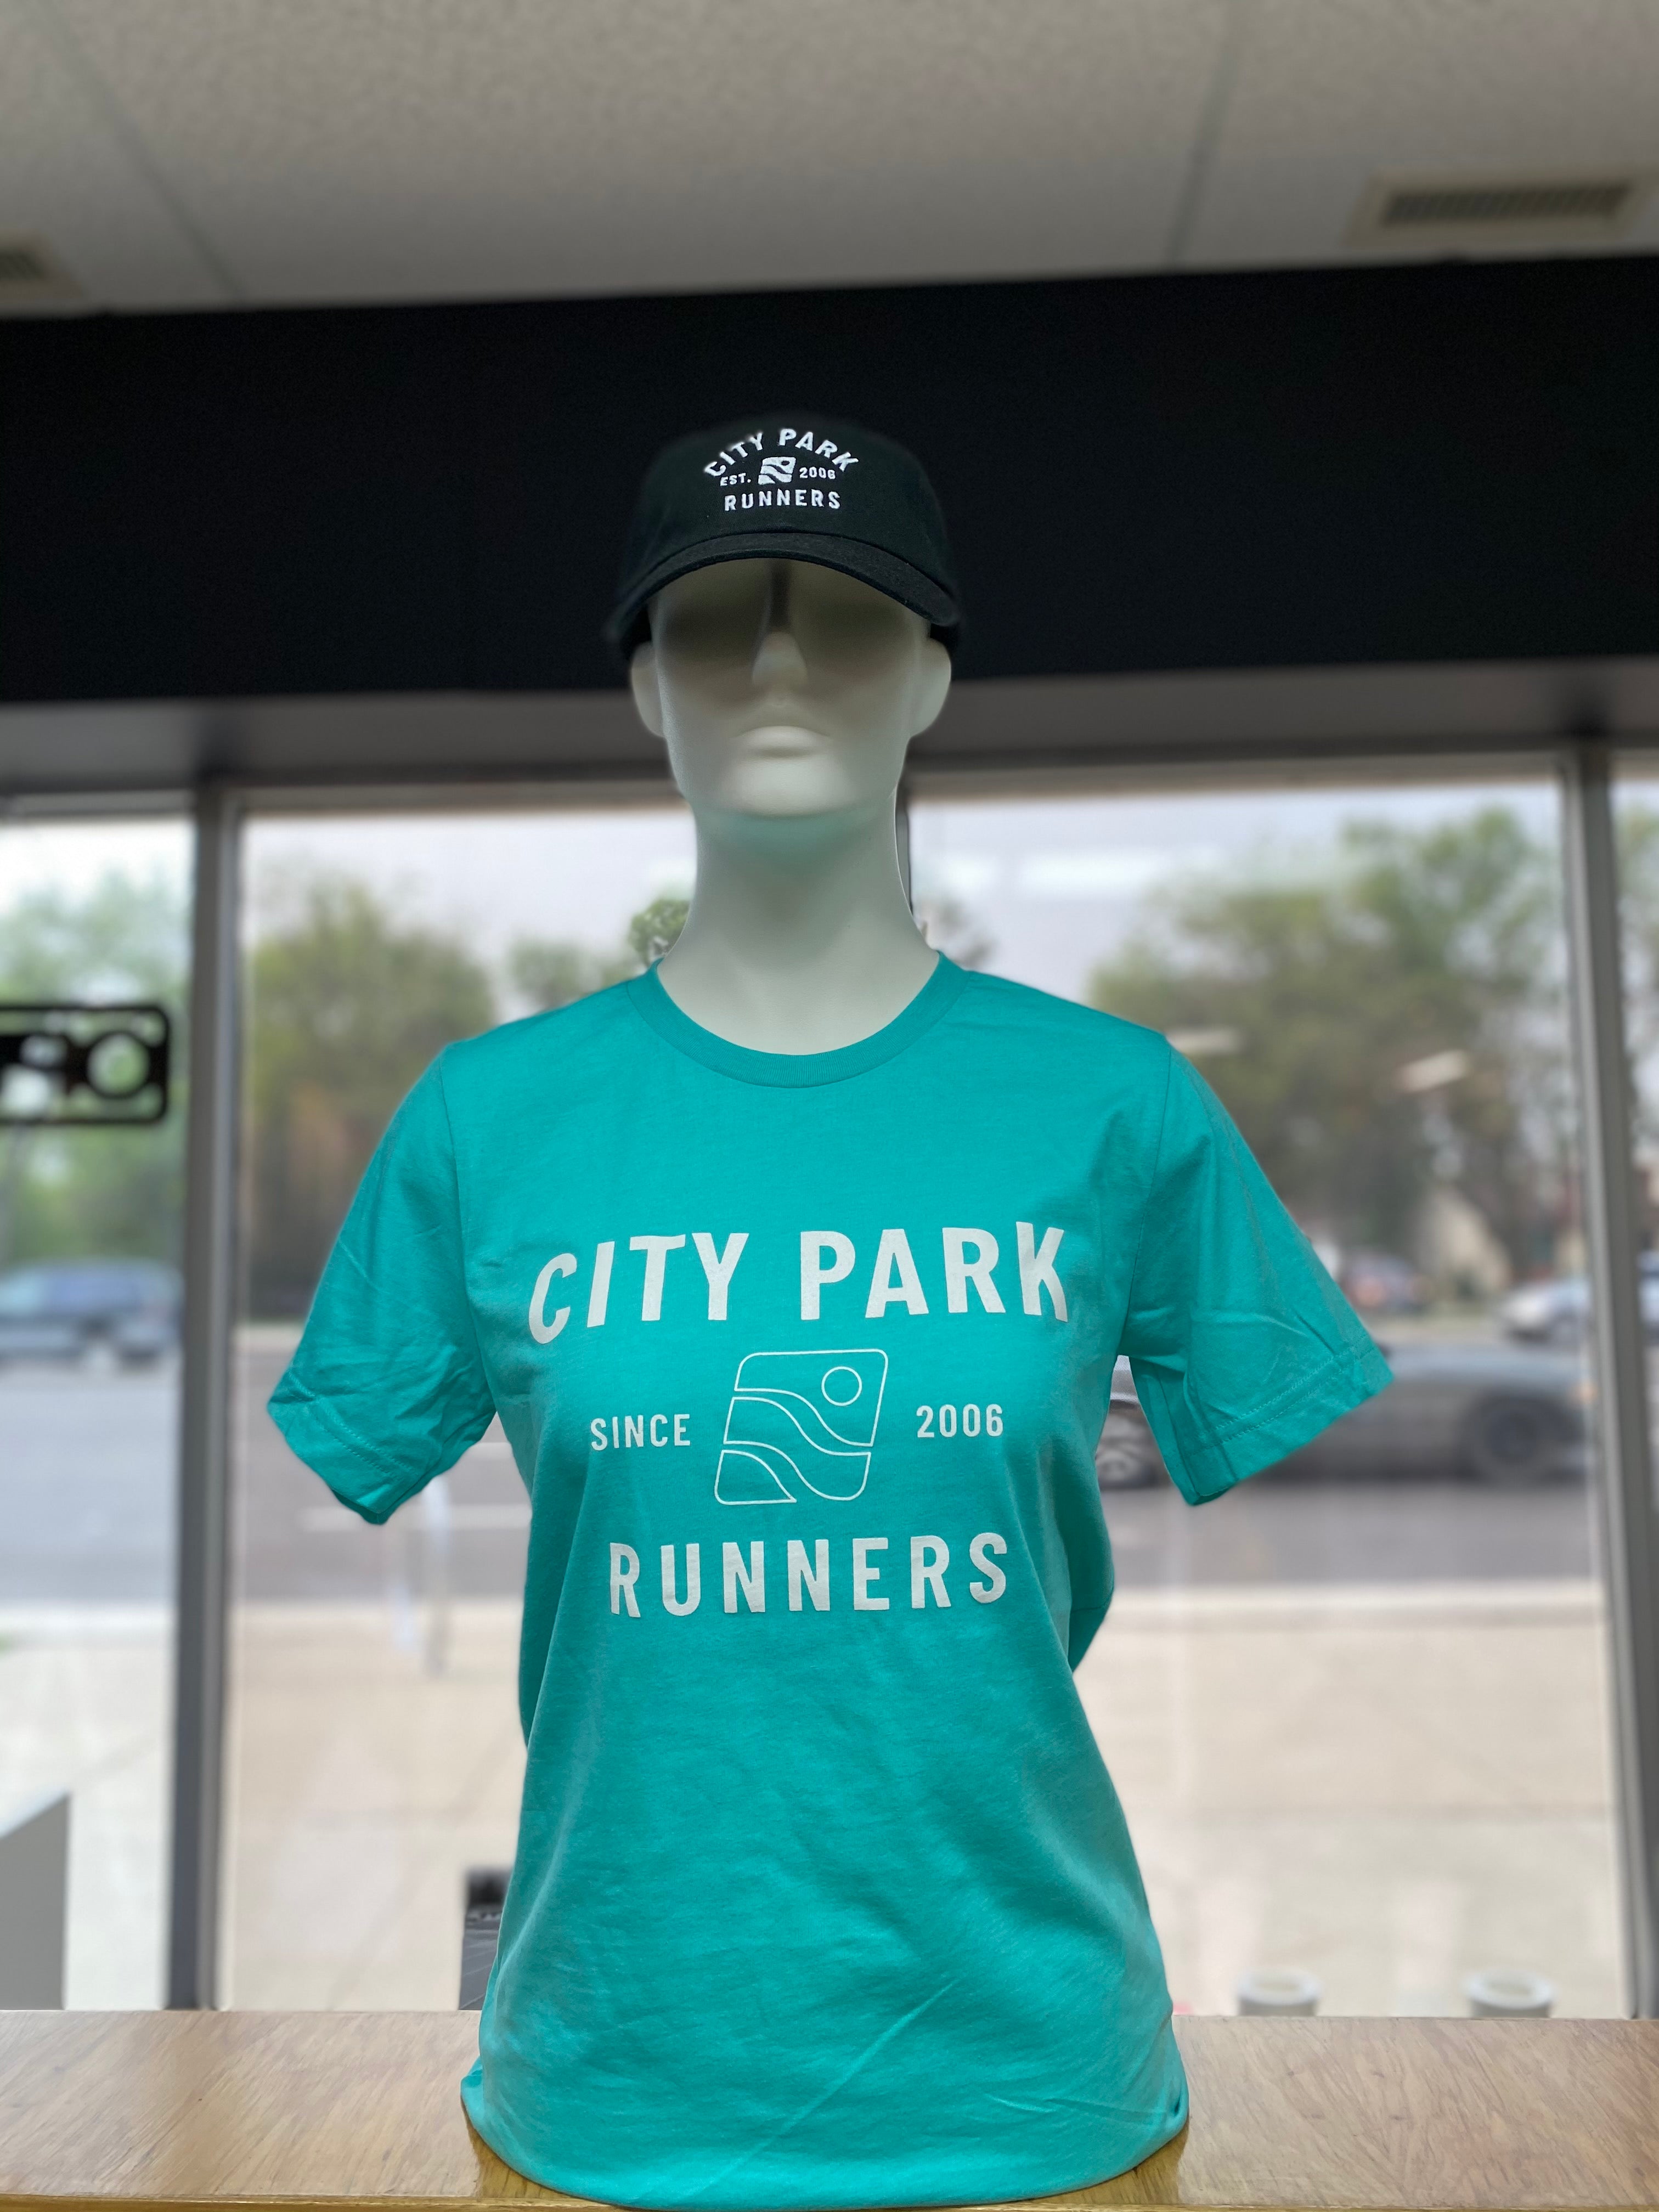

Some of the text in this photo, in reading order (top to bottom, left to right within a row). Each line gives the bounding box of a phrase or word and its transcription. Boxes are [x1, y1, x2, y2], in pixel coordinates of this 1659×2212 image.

[703, 428, 859, 477] CITY PARK
[720, 466, 836, 487] EST. 2006
[724, 488, 840, 511] RUNNERS
[528, 1221, 1068, 1344] CITY PARK
[590, 1404, 1003, 1451] SINCE 2006
[610, 1532, 1007, 1617] RUNNERS
